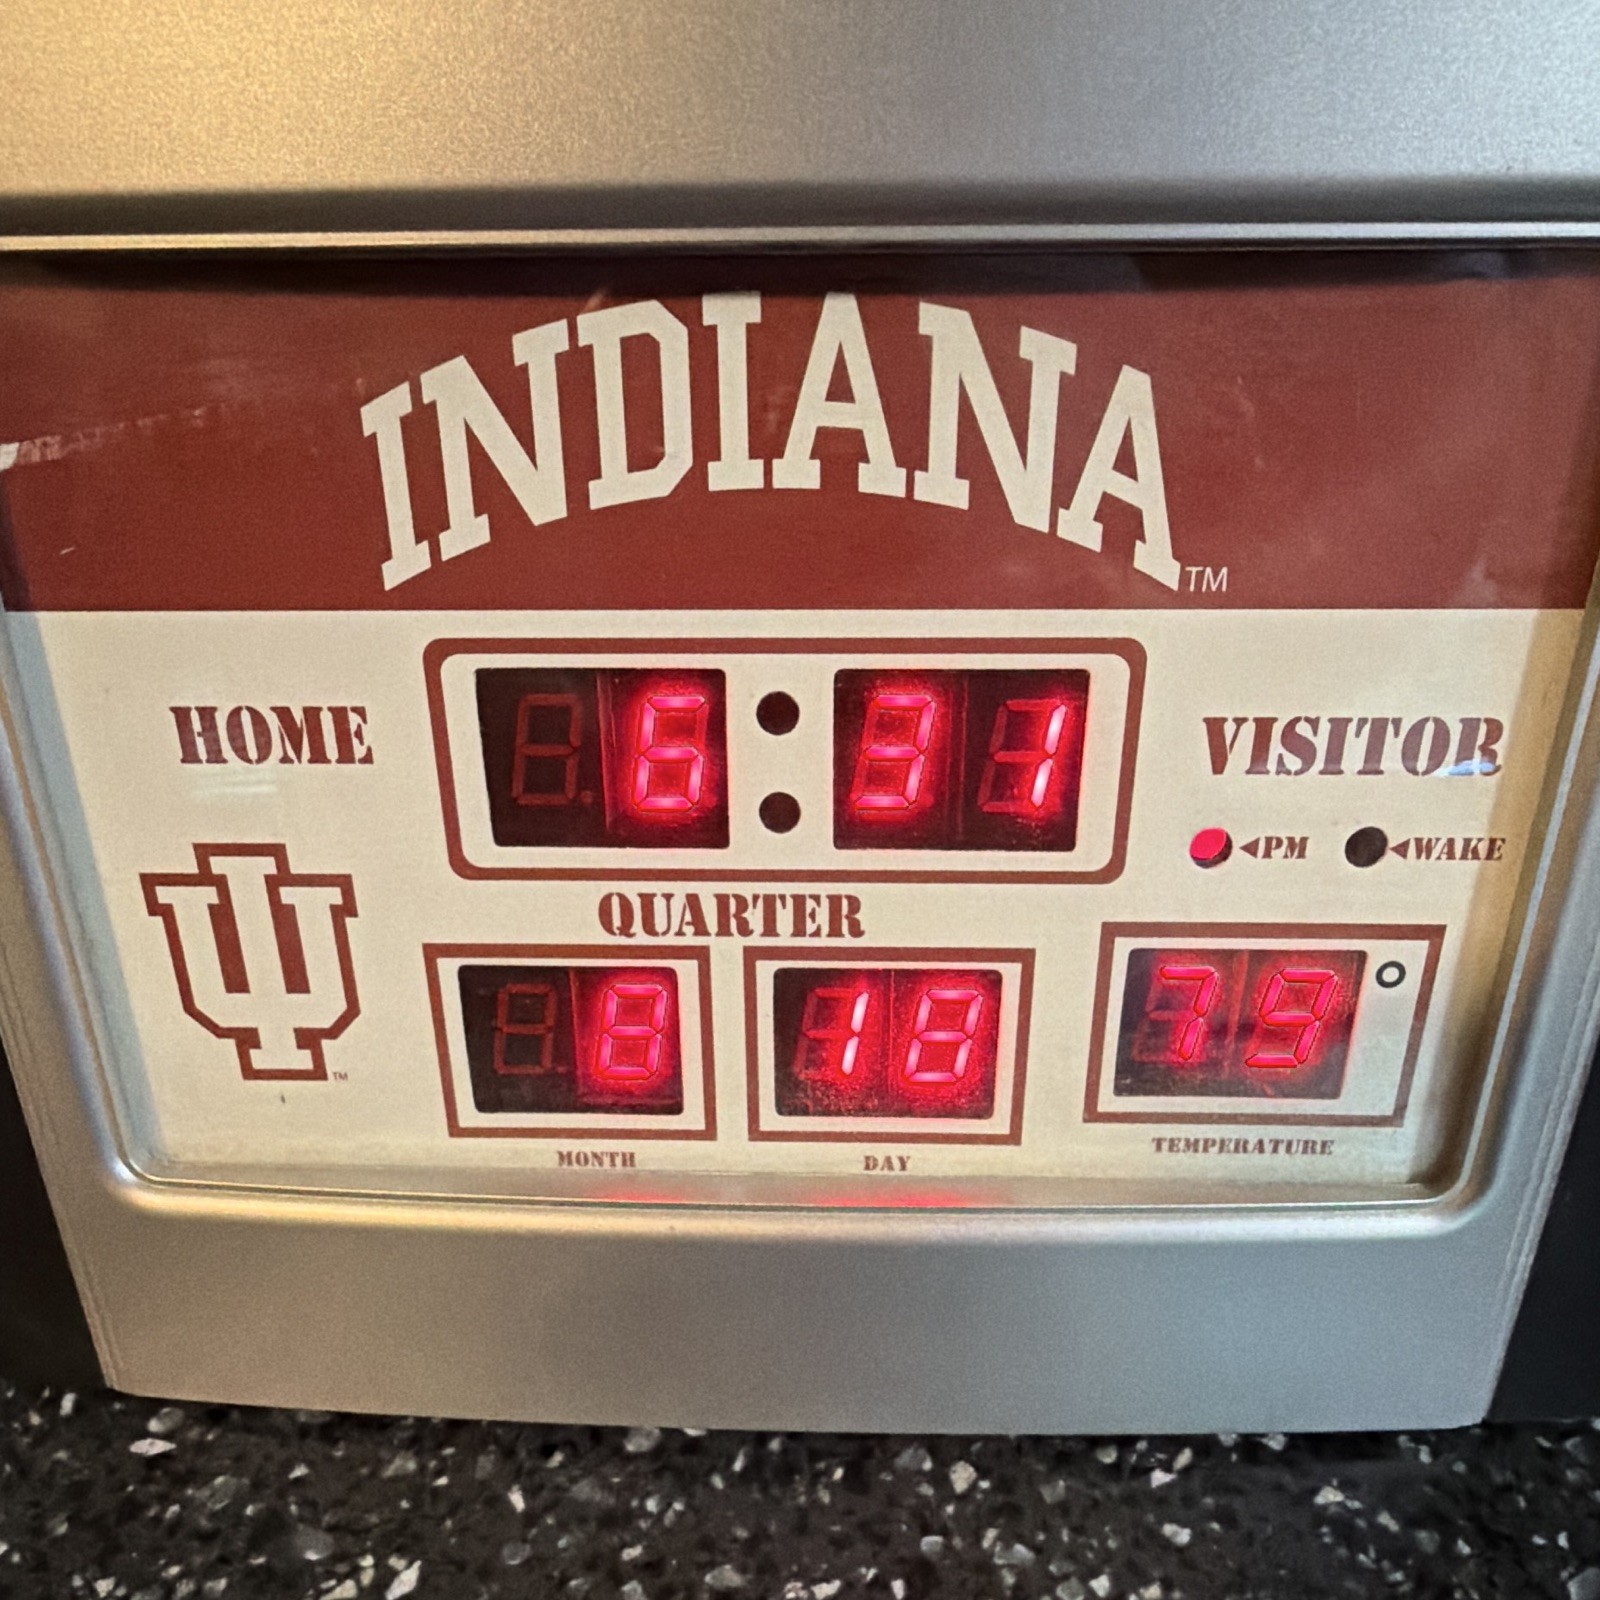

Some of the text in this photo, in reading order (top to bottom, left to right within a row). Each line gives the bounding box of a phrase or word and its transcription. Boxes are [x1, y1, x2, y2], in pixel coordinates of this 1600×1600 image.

[360, 291, 1180, 592] INDIANA
[1186, 566, 1229, 593] TM
[169, 706, 374, 765] HOME
[1202, 716, 1505, 777] VISITOR
[1261, 836, 1309, 860] PM
[1414, 837, 1506, 861] WAKE
[598, 892, 866, 938] QUARTER
[600, 983, 668, 1081] 8
[841, 987, 984, 1084] 18
[557, 1150, 636, 1169] MONTH
[864, 1154, 911, 1172] DAY
[1152, 1136, 1335, 1156] TEMPERATURE
